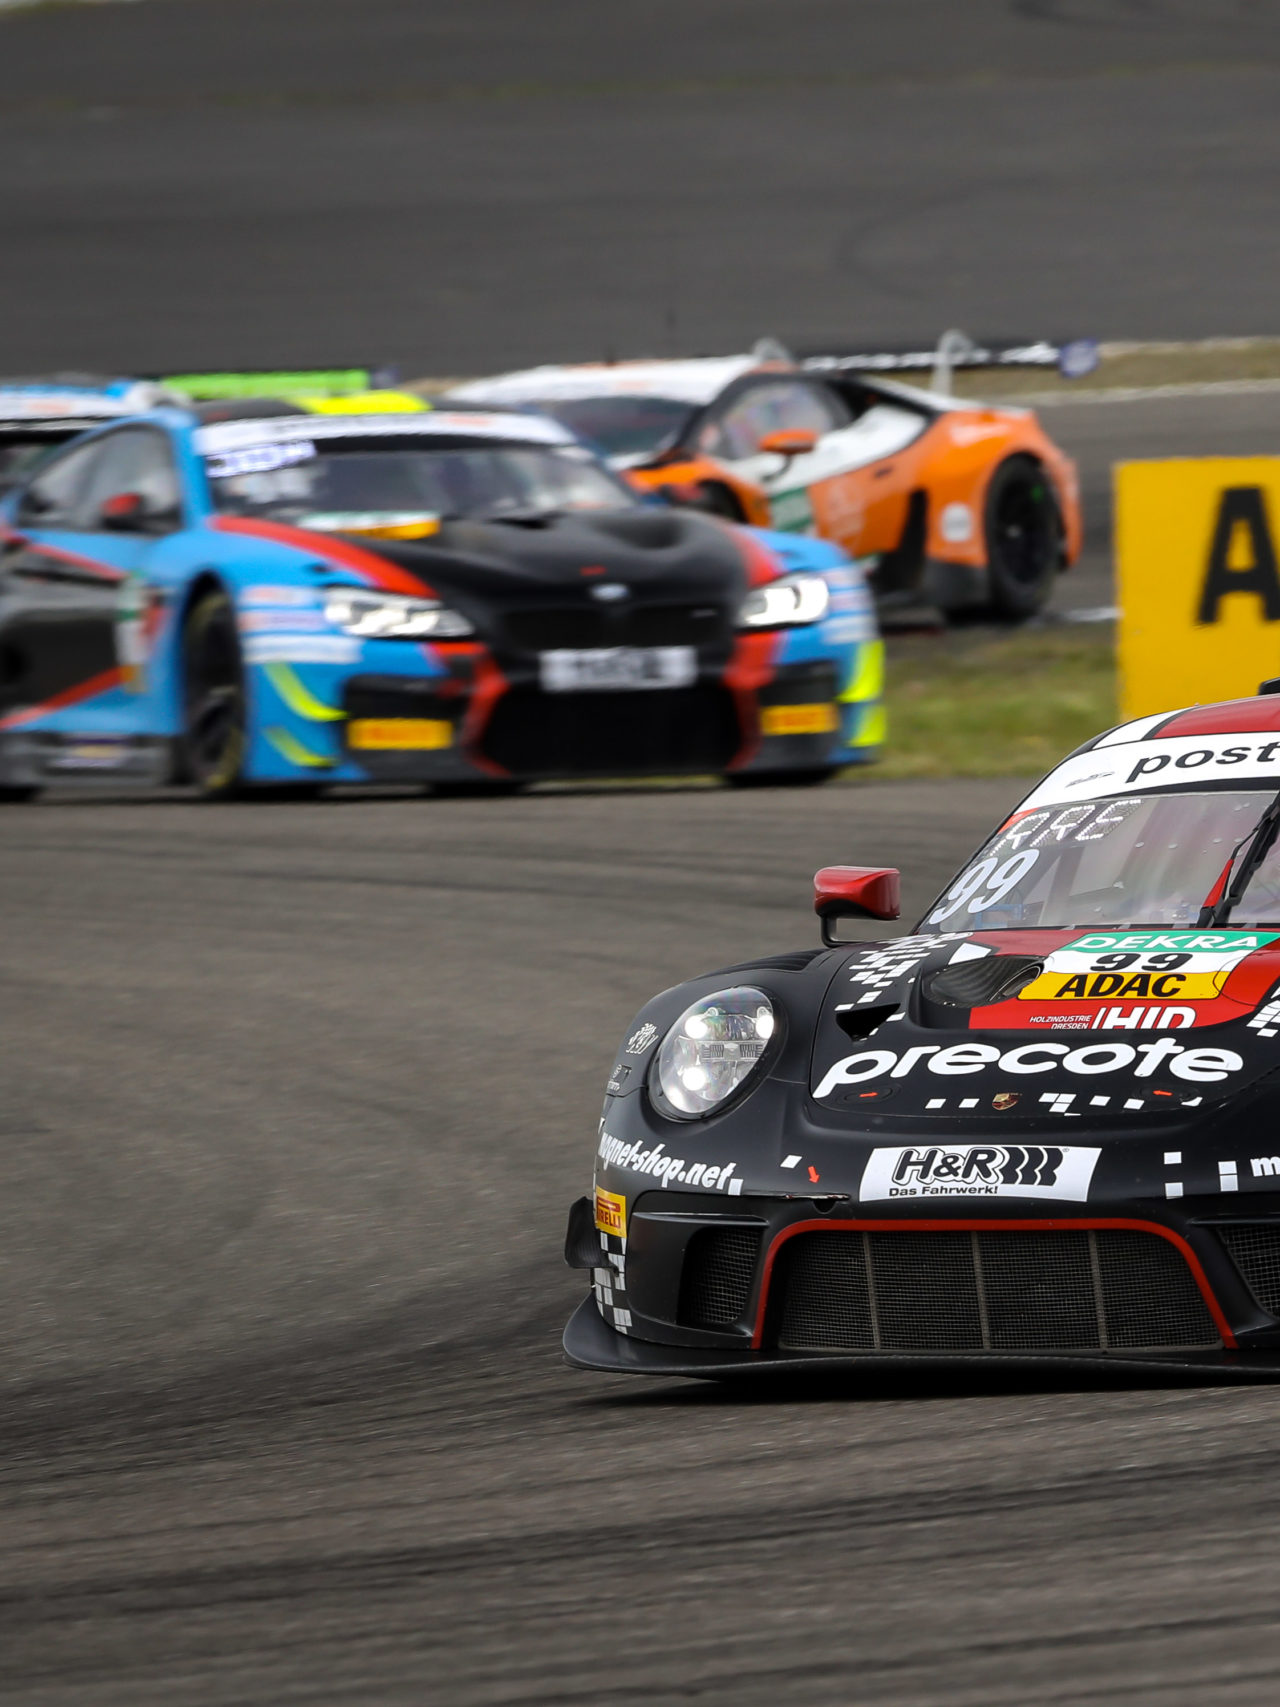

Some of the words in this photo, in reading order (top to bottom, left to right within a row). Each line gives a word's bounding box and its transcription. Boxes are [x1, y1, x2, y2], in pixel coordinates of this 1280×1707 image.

[929, 850, 1040, 925] 99
[1072, 935, 1258, 949] DEKRA
[1090, 953, 1193, 971] 99
[1054, 974, 1186, 997] ADAC
[1029, 1015, 1093, 1023] HOLZINDUSTRIE
[812, 1037, 1244, 1098] precote
[893, 1149, 1002, 1185] H&R
[889, 1187, 917, 1197] Das
[921, 1185, 998, 1196] Fahrwerk!
